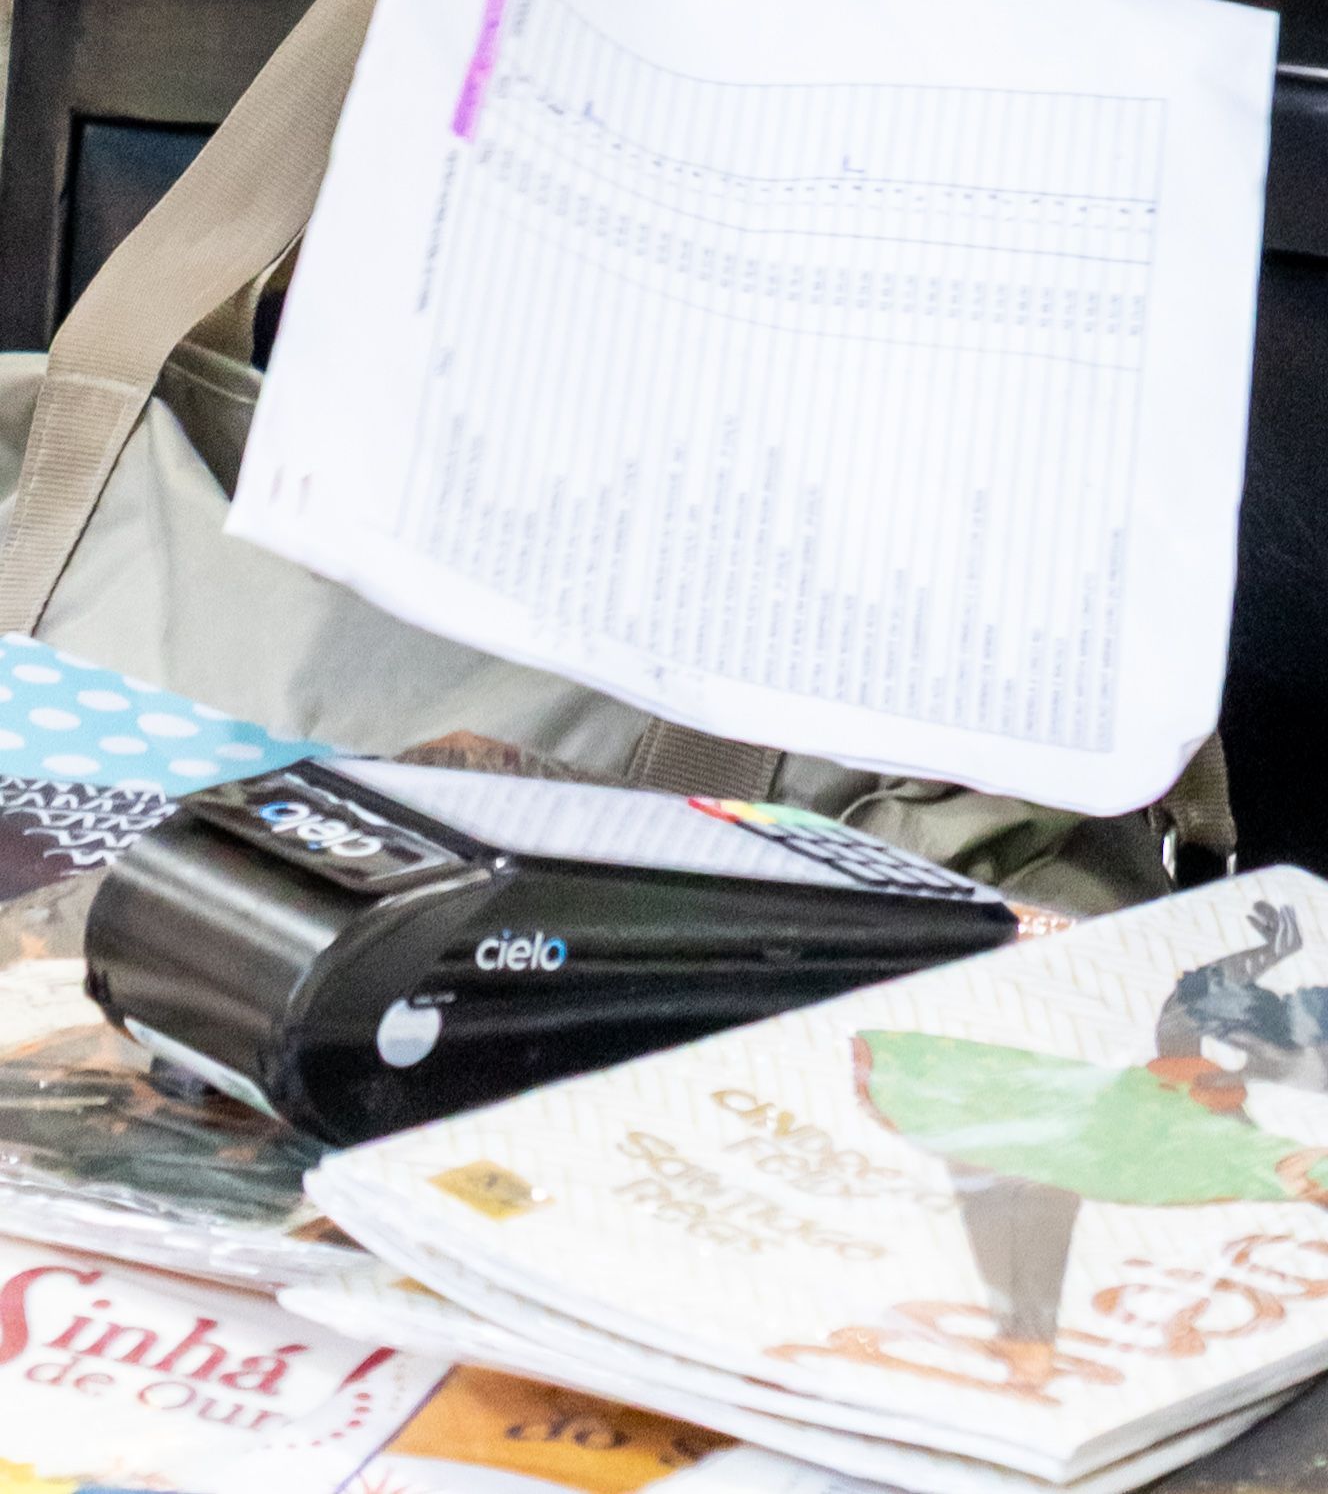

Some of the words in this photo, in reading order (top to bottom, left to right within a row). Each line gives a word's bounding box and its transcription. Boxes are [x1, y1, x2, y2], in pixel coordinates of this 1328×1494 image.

[258, 800, 384, 858] cielo
[474, 928, 569, 972] cielo
[0, 1265, 311, 1397] Sinhá
[25, 1355, 116, 1398] de
[137, 1379, 294, 1434] Our
